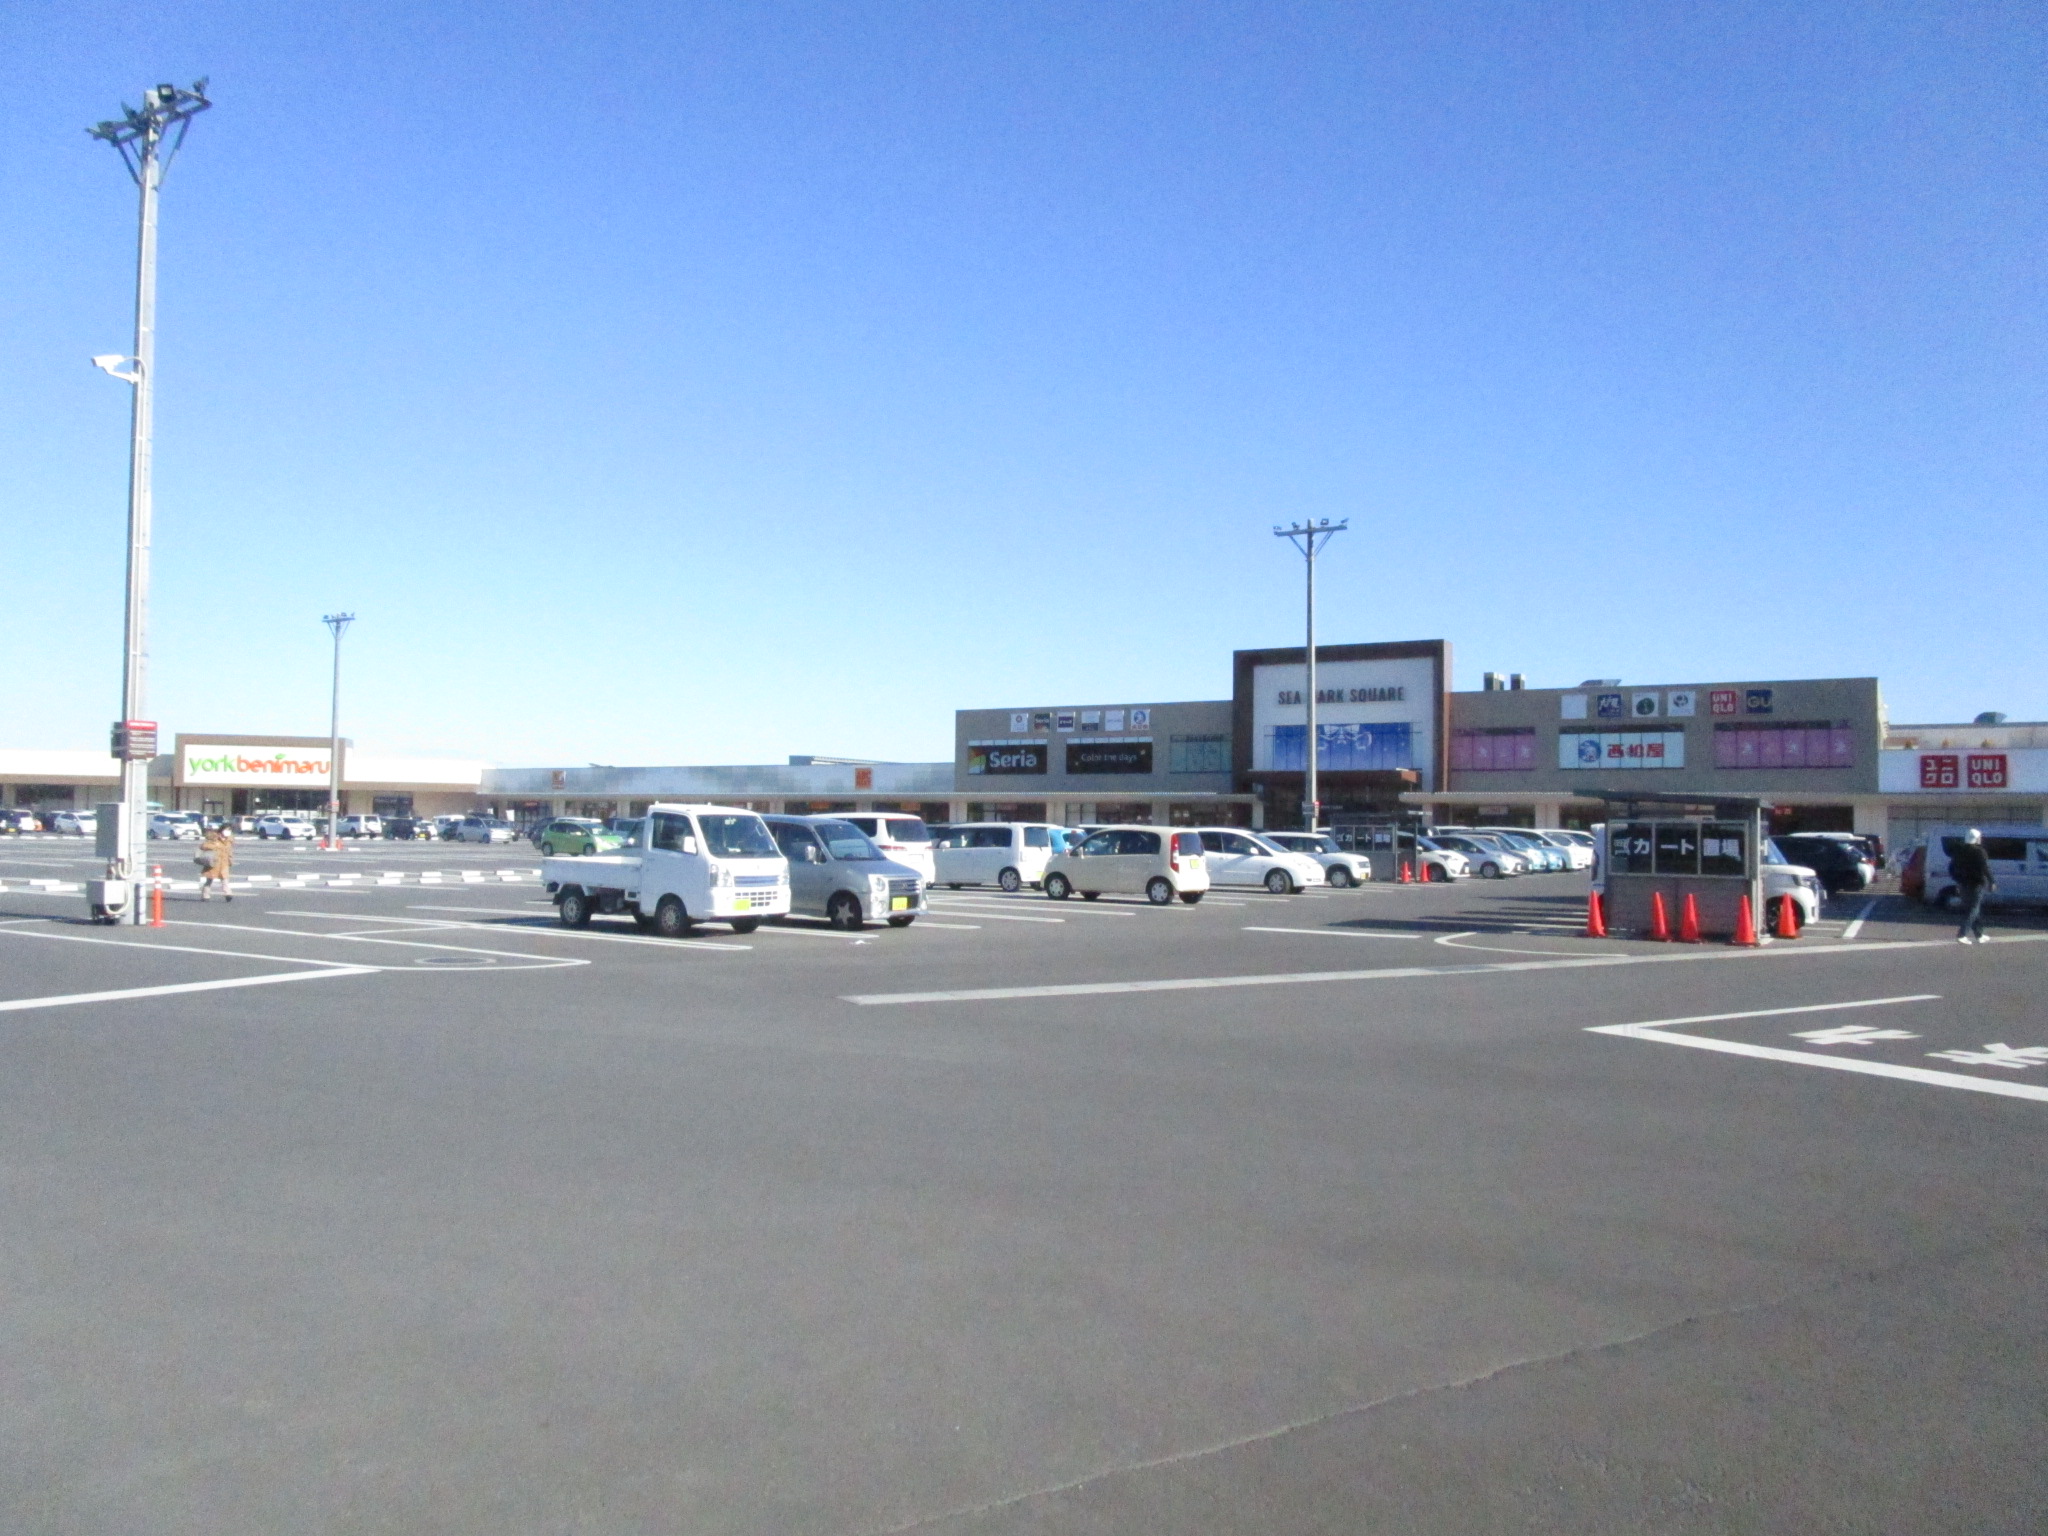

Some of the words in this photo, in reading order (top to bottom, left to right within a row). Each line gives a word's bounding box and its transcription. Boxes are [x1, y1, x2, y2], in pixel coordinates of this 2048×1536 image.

[1278, 690, 1302, 705] SEA
[1315, 688, 1345, 704] ARK
[1349, 686, 1405, 702] SQUARE
[1747, 695, 1770, 708] GU
[989, 750, 1037, 768] Seria
[1972, 758, 2000, 771] UNI
[1972, 772, 2003, 786] QLO
